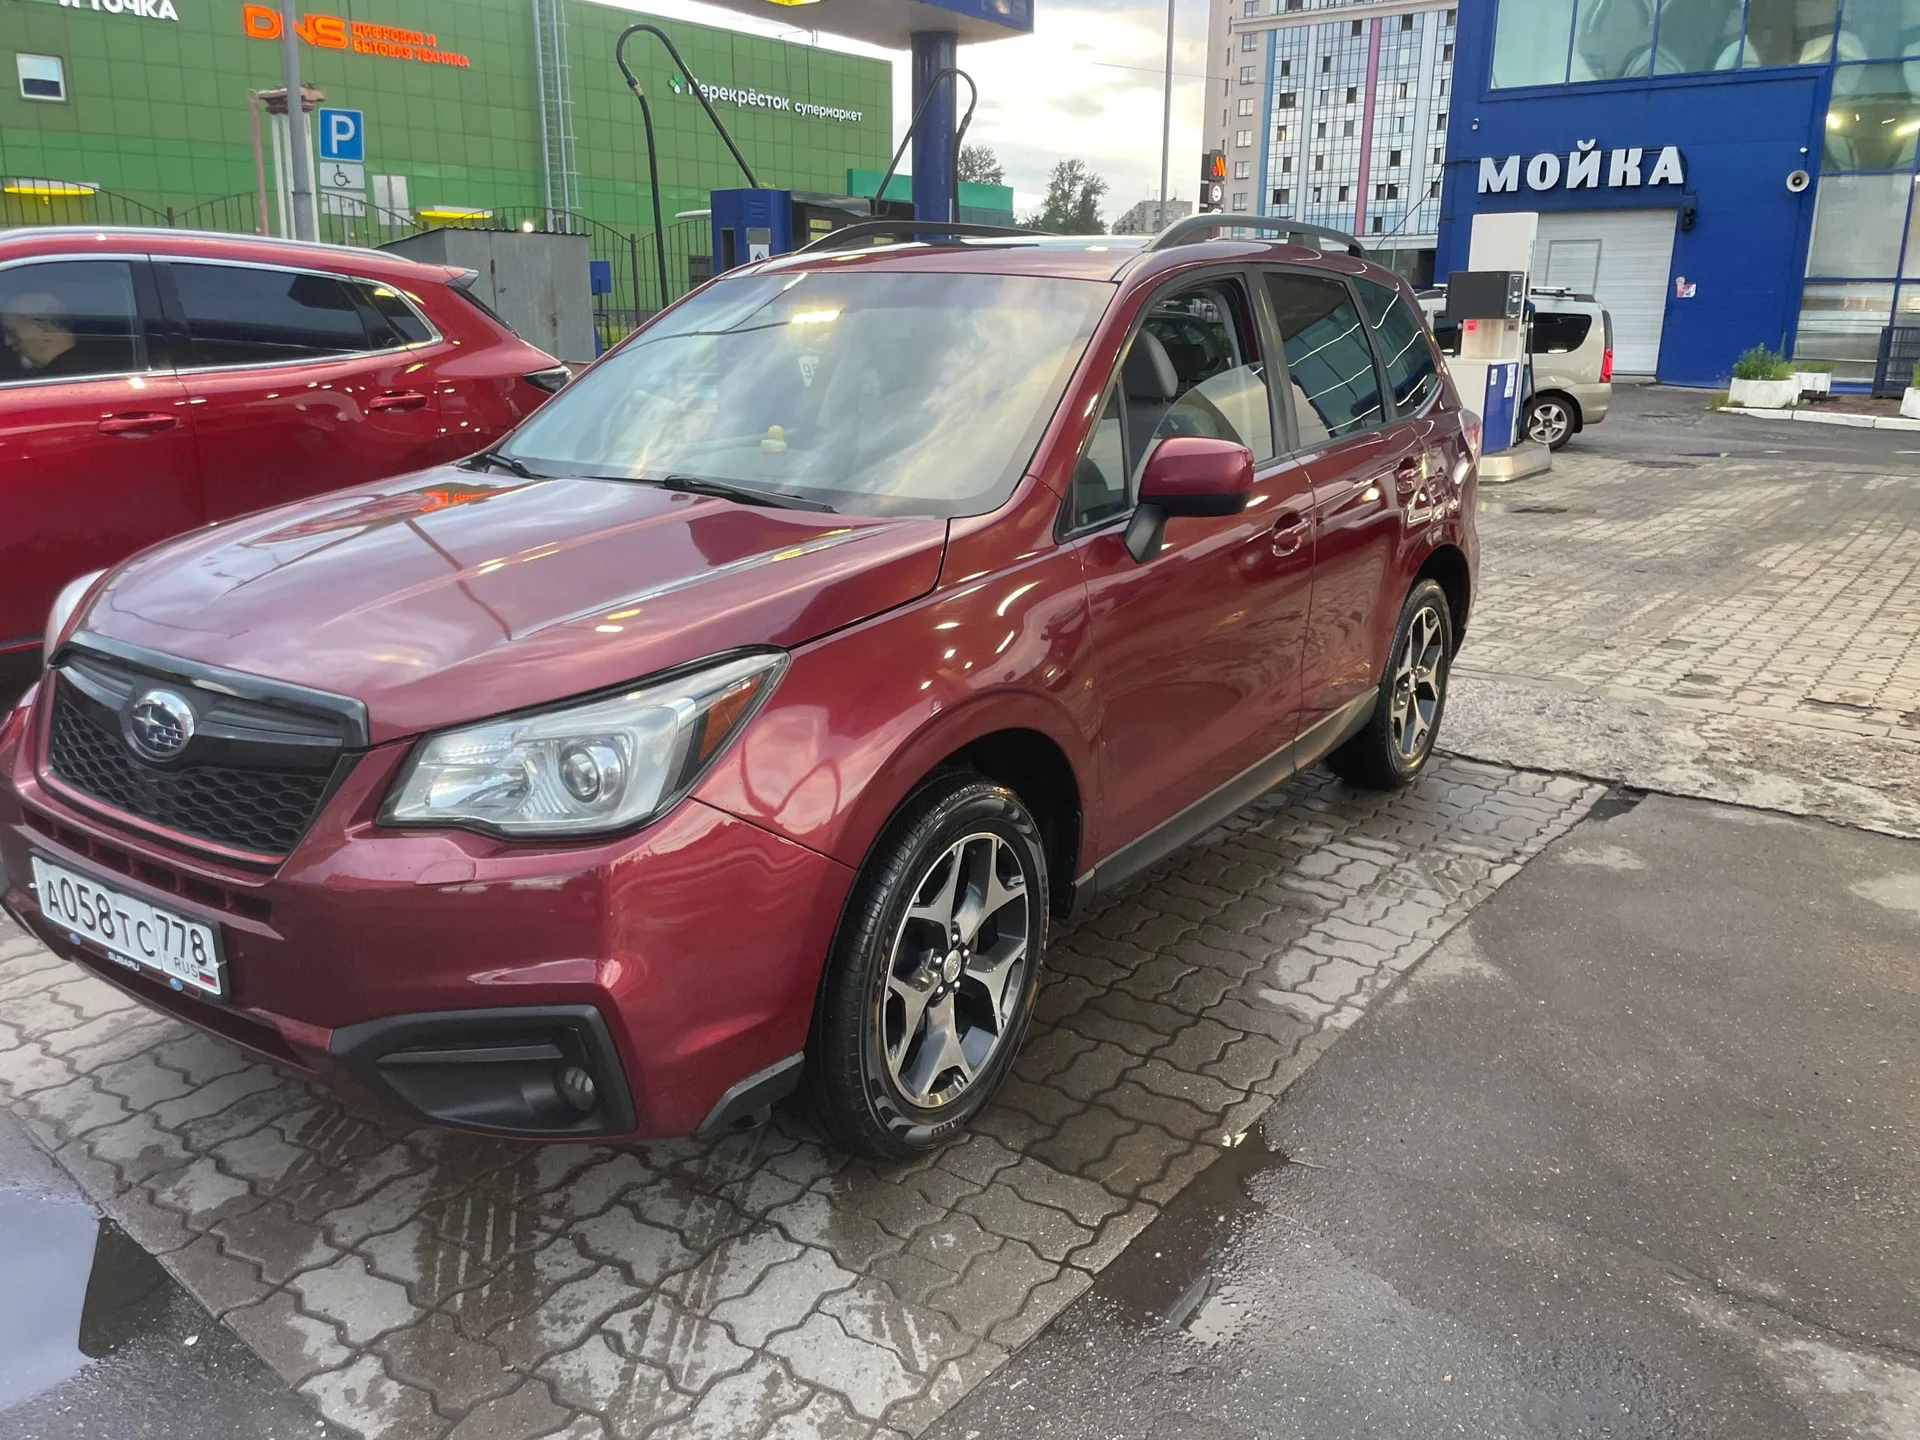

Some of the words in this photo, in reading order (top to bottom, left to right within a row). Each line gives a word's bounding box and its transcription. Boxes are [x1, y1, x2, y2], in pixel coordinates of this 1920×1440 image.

[243, 4, 348, 49] DNS
[351, 21, 424, 46] ЦИФРОВАЯ
[427, 34, 436, 48] И
[353, 39, 412, 60] БЫТОВАЯ
[415, 47, 470, 68] ТЕХНИКА
[794, 101, 862, 122] супермаркет
[331, 114, 355, 154] P
[1478, 139, 1684, 194] МОЙКА
[174, 957, 199, 979] RUS
